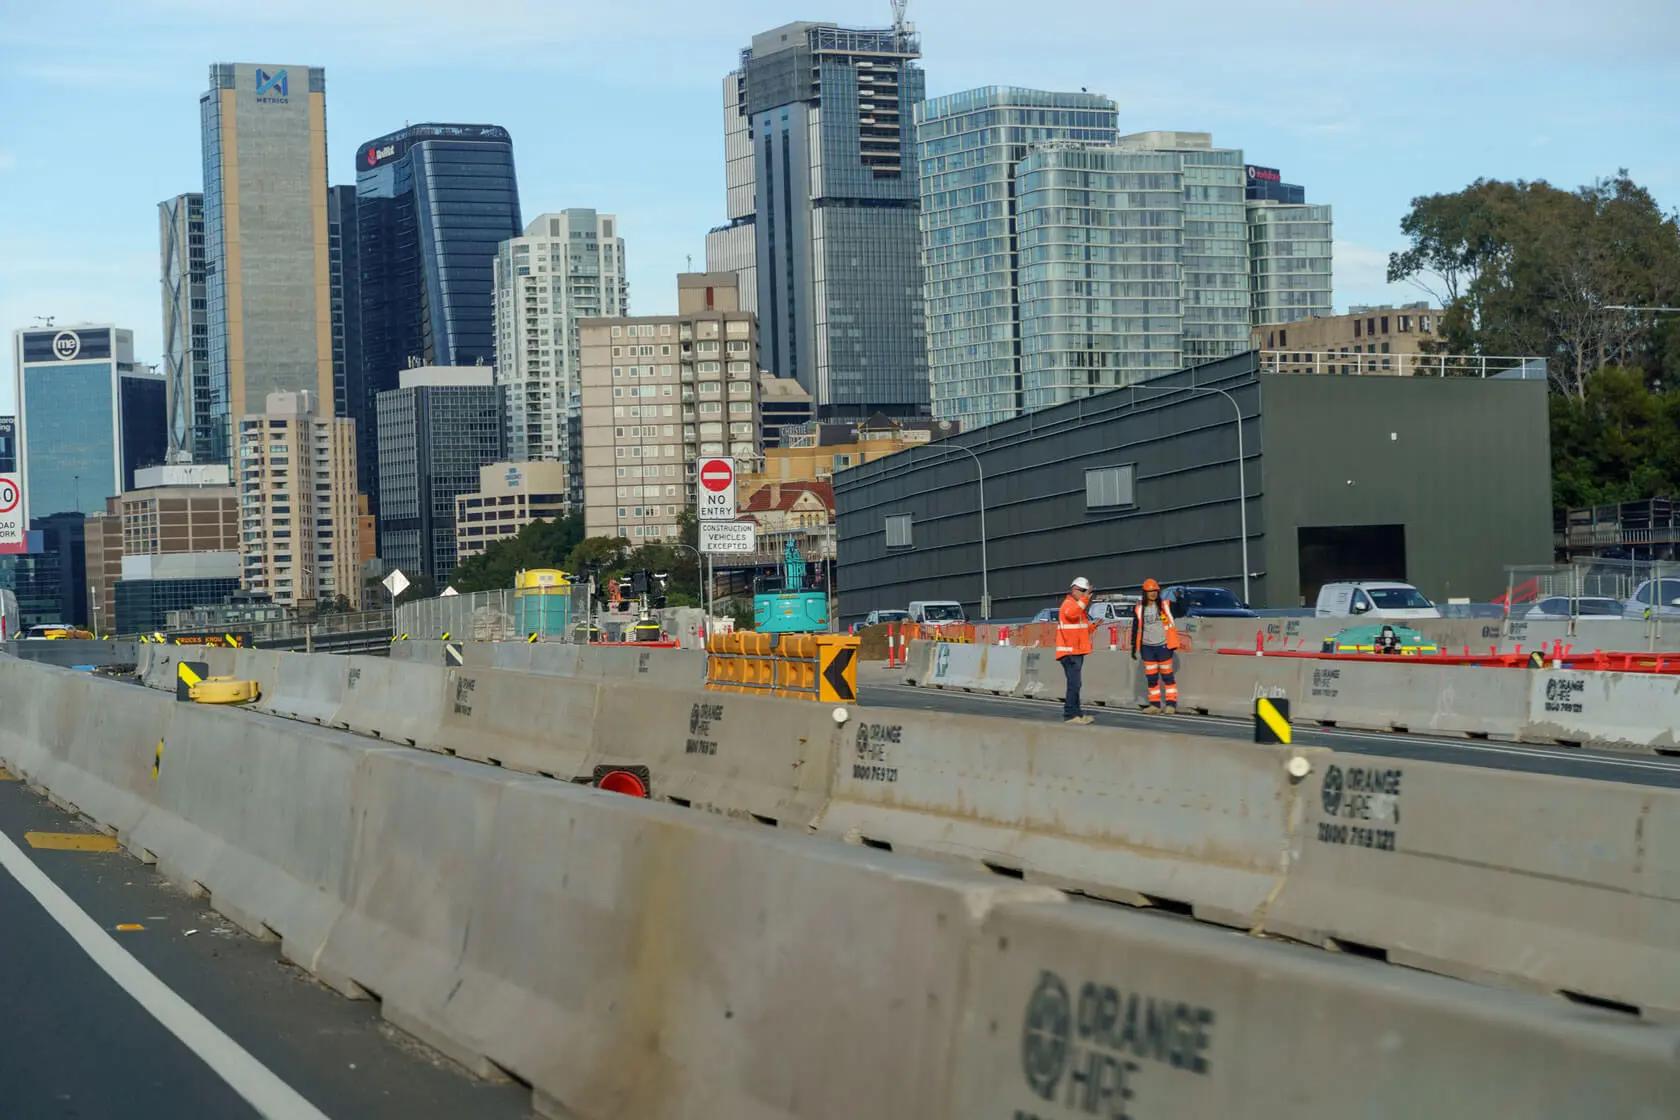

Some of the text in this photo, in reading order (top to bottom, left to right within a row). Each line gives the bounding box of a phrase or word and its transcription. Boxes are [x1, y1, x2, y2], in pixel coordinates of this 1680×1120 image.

[57, 339, 76, 349] me
[708, 495, 726, 504] NO
[701, 507, 732, 515] ENTRY
[870, 724, 902, 743] ORANGE
[1346, 767, 1402, 795] ORANGE
[1078, 982, 1214, 1075] ORANGE
